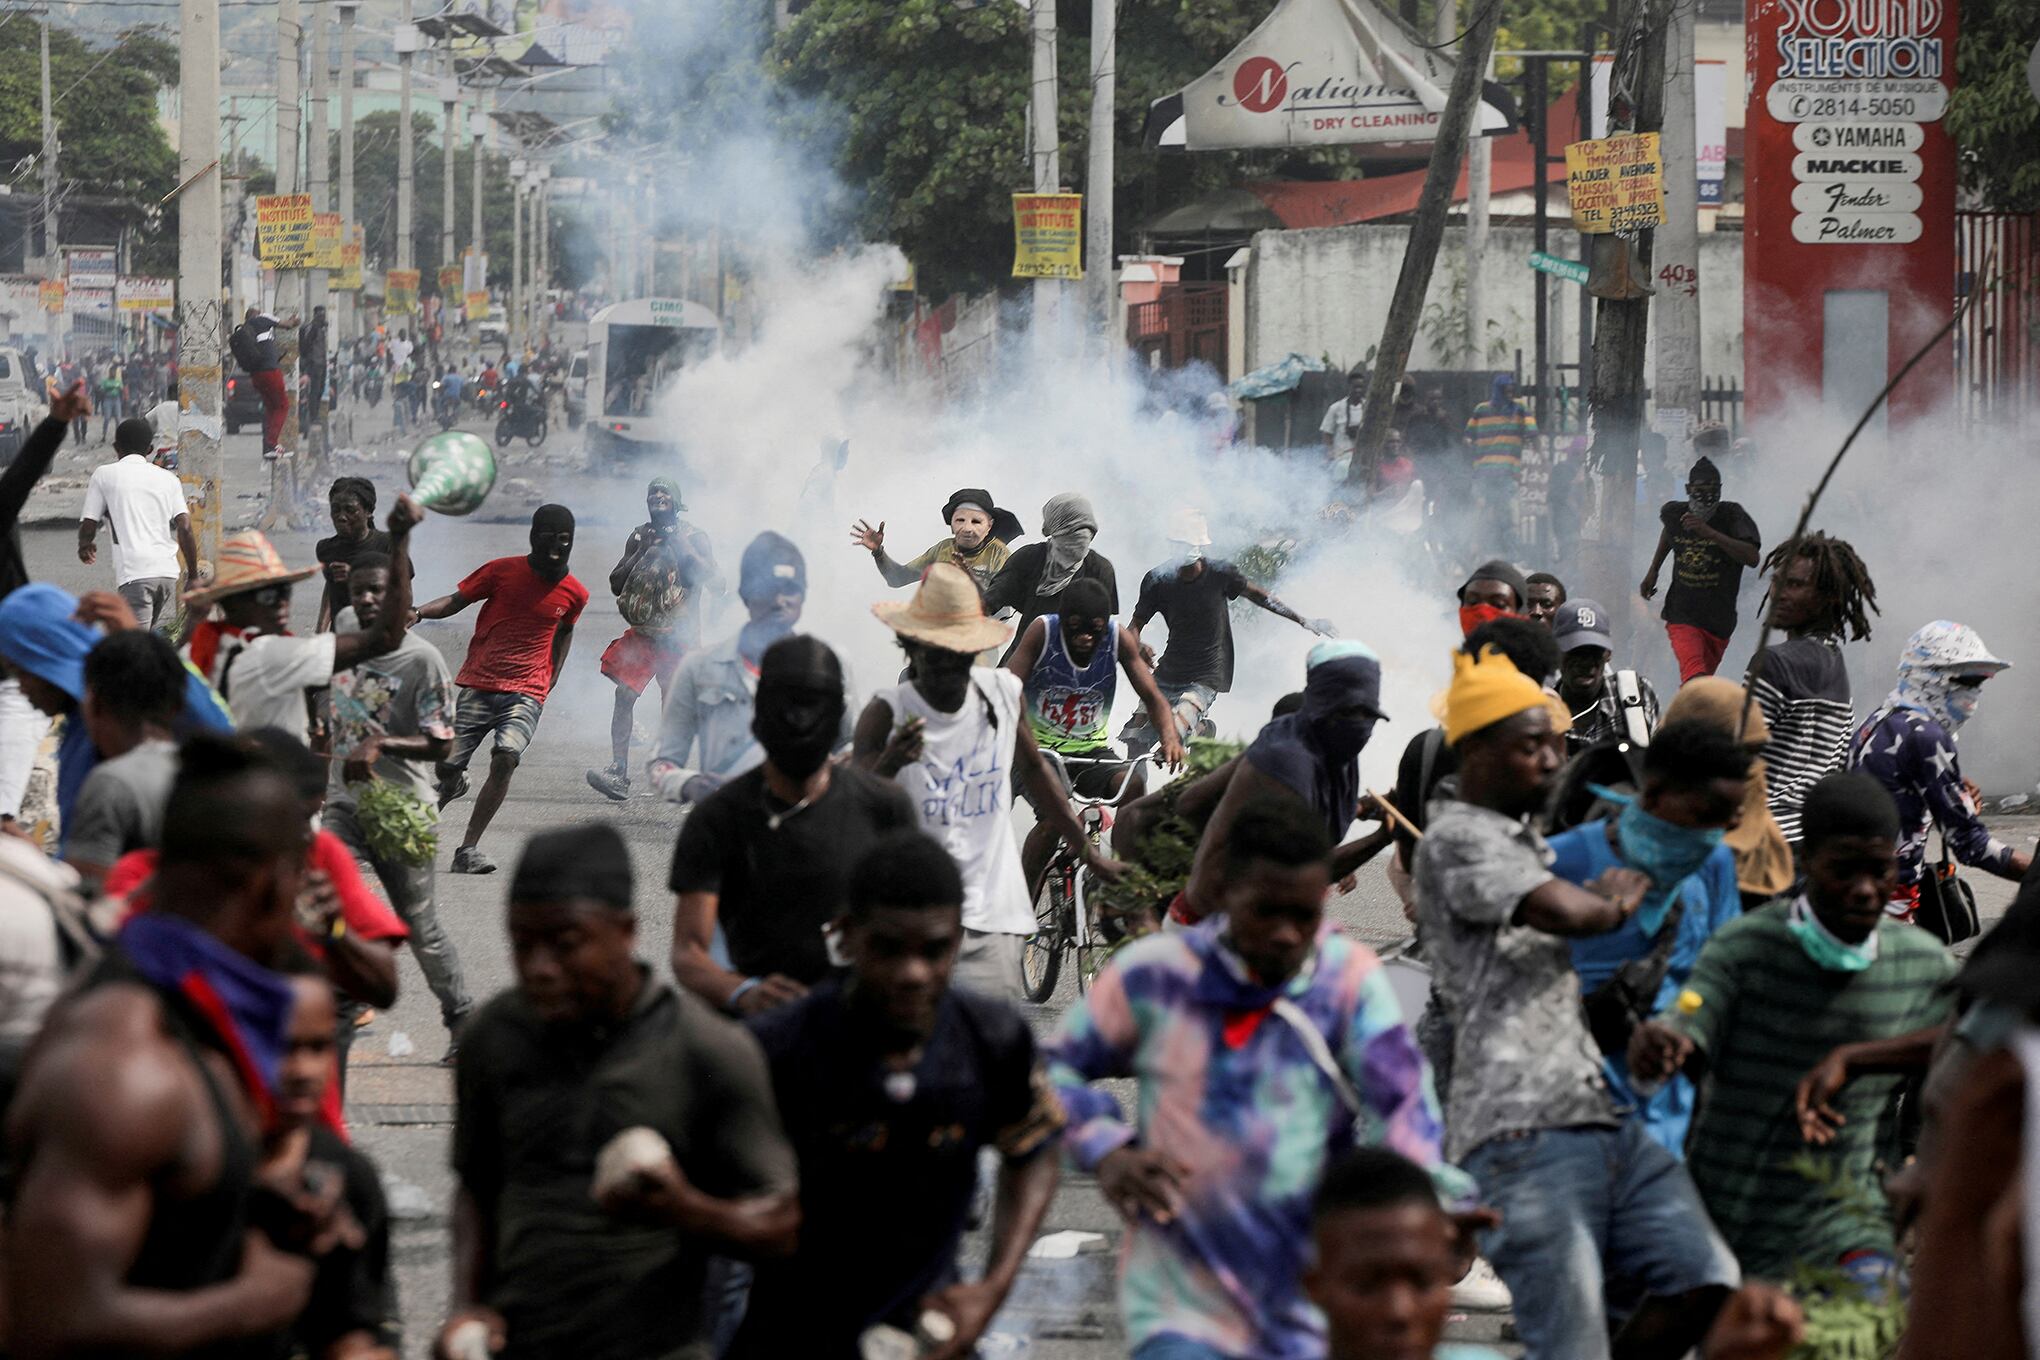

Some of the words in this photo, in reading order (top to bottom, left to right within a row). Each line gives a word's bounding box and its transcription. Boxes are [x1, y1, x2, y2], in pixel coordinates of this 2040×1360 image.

[1777, 0, 1943, 39] SOUND
[1777, 35, 1943, 79] SELECTION
[1777, 82, 1862, 93] INSTRUMENTS
[1866, 82, 1881, 93] DE
[1884, 82, 1939, 93] MUSIQUE
[1813, 98, 1915, 117] 2814-5050
[1313, 117, 1345, 131] DRY
[1351, 112, 1438, 128] CLEANING
[1835, 127, 1906, 147] YAMAHA
[1824, 182, 1890, 212] Fender
[259, 208, 307, 222] INSTITUTE
[1583, 210, 1603, 222] TEL
[1818, 217, 1896, 240] Palmer
